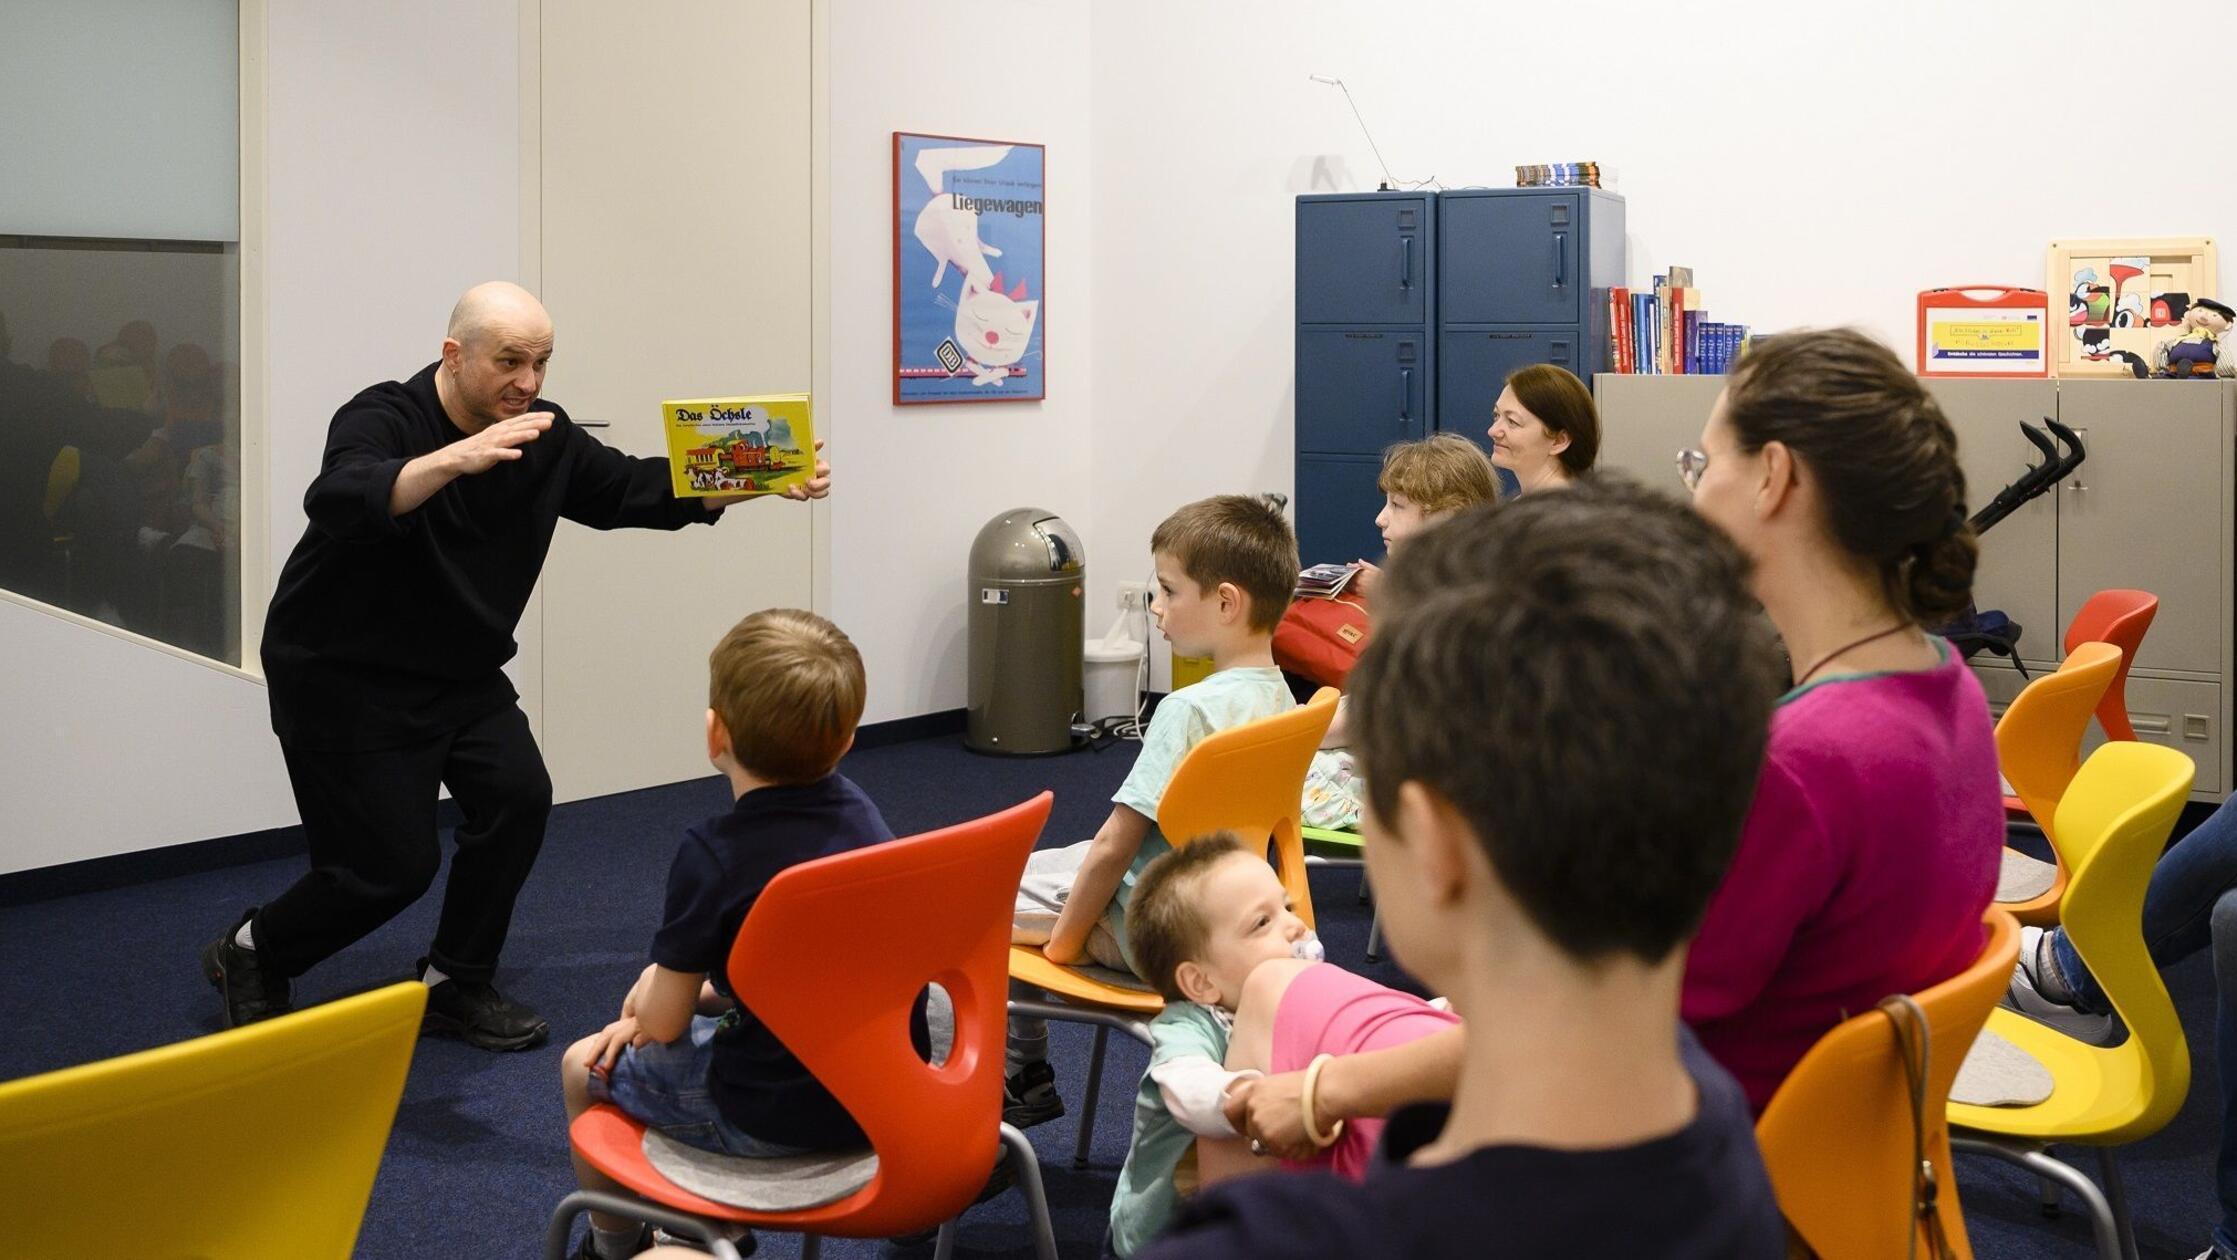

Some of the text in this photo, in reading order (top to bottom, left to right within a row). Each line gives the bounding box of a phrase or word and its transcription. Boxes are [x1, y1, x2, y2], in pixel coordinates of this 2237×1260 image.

[952, 193, 1043, 218] Liegewagen
[676, 405, 753, 423] Das Öchsle
